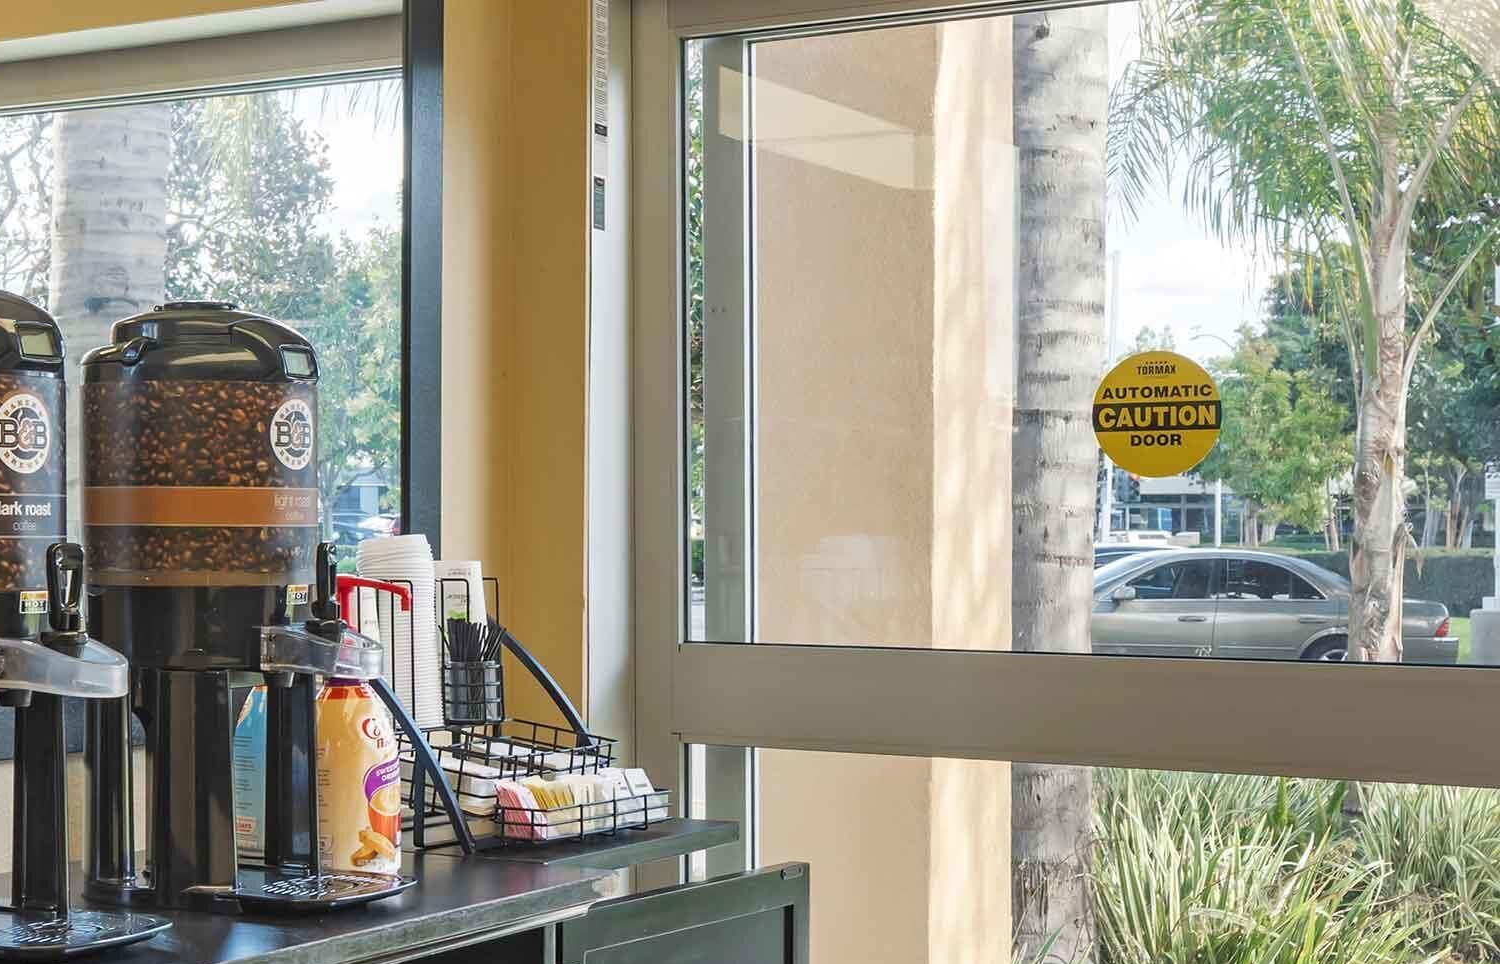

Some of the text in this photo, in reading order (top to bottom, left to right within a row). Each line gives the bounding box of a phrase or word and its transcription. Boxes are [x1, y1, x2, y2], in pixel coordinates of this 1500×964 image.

[1136, 364, 1177, 375] TORMAX
[1102, 384, 1213, 400] AUTOMATIC
[1098, 404, 1216, 429] CAUTION
[1130, 433, 1183, 447] DOOR
[25, 501, 52, 516] roast
